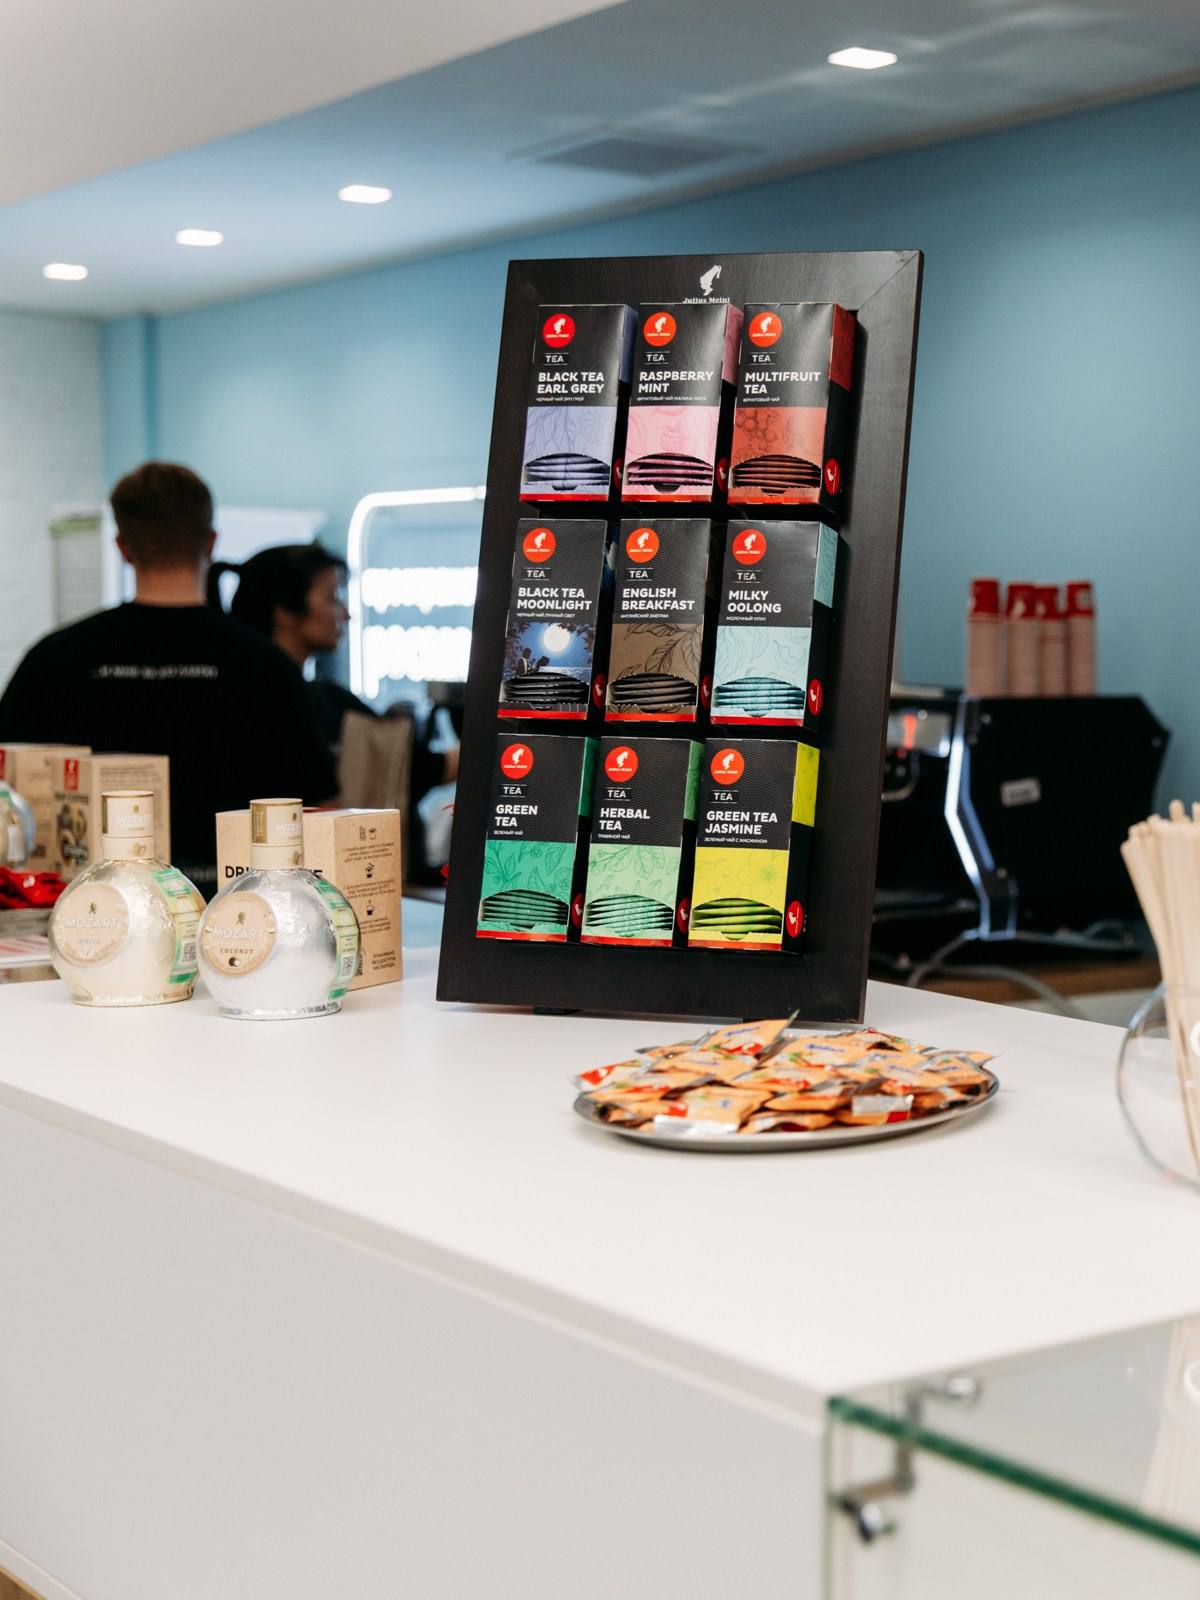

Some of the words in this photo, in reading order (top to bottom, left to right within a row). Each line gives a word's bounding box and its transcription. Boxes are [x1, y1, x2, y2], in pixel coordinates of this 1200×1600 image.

[545, 355, 564, 363] TEA
[646, 354, 665, 362] TEA
[752, 354, 771, 362] TEA
[538, 372, 578, 382] BLACK
[580, 372, 604, 382] TEA
[639, 371, 714, 381] RASPBERRY
[745, 371, 821, 382] MULTIFRUIT
[537, 383, 568, 394] EARL
[570, 383, 605, 394] GREY
[638, 383, 670, 393] MINT
[744, 384, 767, 394] TEA
[526, 569, 546, 578] TEA
[629, 570, 649, 578] TEA
[737, 572, 756, 581] TEA
[518, 587, 559, 598] BLACK
[561, 588, 585, 598] TEA
[622, 588, 677, 598] ENGLISH
[728, 590, 769, 600] MILKY
[516, 599, 592, 610] MOONLIGHT
[621, 600, 695, 610] BREAKFAST
[727, 602, 782, 613] OOLONG
[503, 786, 522, 795] TEA
[608, 790, 626, 798] TEA
[714, 792, 733, 801] TEA
[496, 804, 538, 815] GREEN
[600, 807, 650, 819] HERBAL
[495, 816, 518, 827] TEA
[706, 810, 750, 822] GREEN
[752, 811, 778, 823] TEA
[599, 820, 622, 831] TEA
[705, 823, 762, 835] JASMINE
[65, 917, 119, 929] MOZART
[212, 927, 266, 940] MOZART
